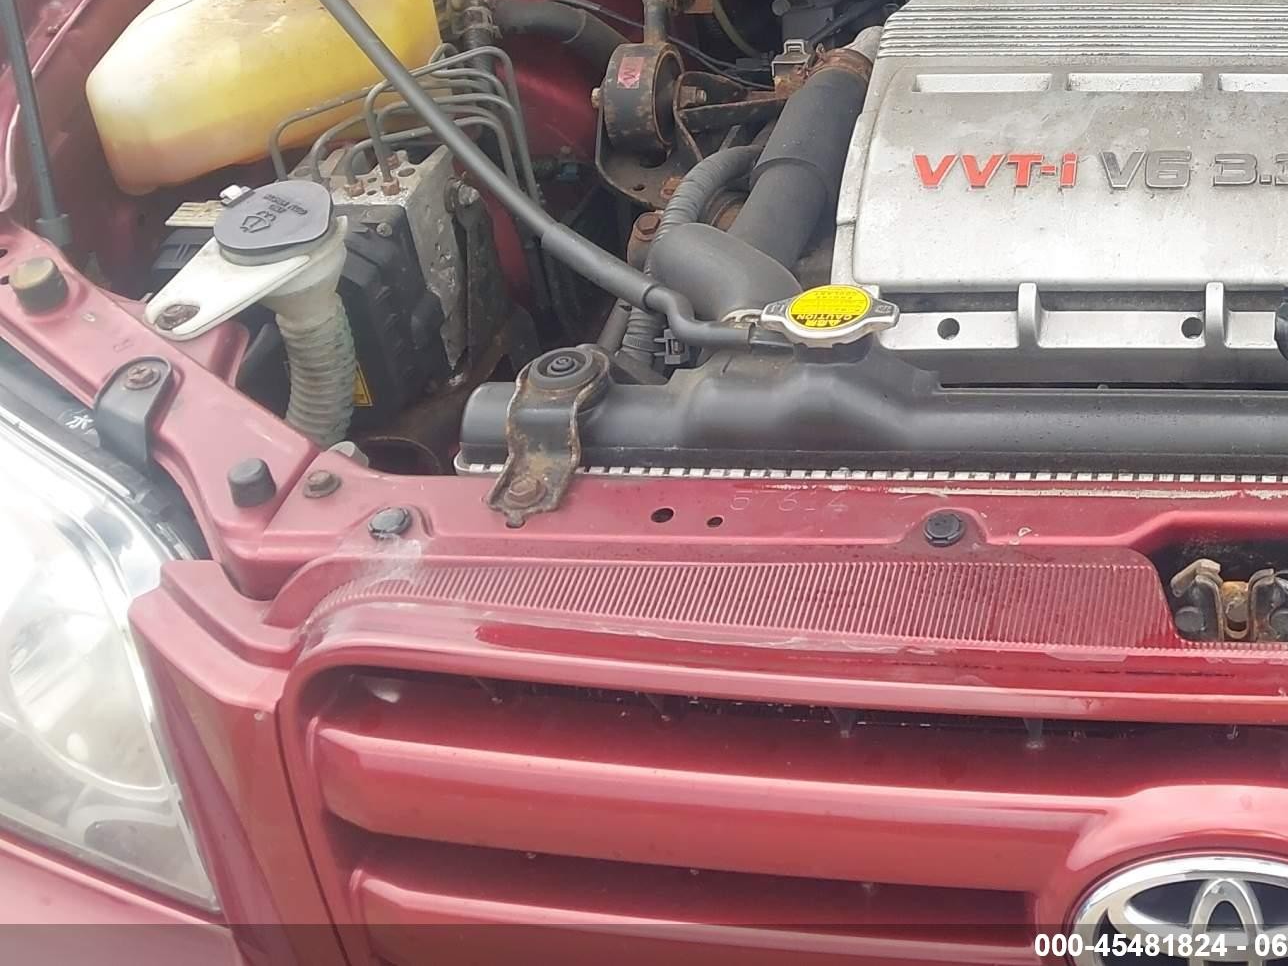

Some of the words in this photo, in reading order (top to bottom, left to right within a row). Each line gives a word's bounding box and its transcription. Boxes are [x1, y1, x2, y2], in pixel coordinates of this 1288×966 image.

[913, 152, 1080, 190] VVT-i
[1100, 149, 1193, 190] V6
[796, 313, 853, 321] CAUTION
